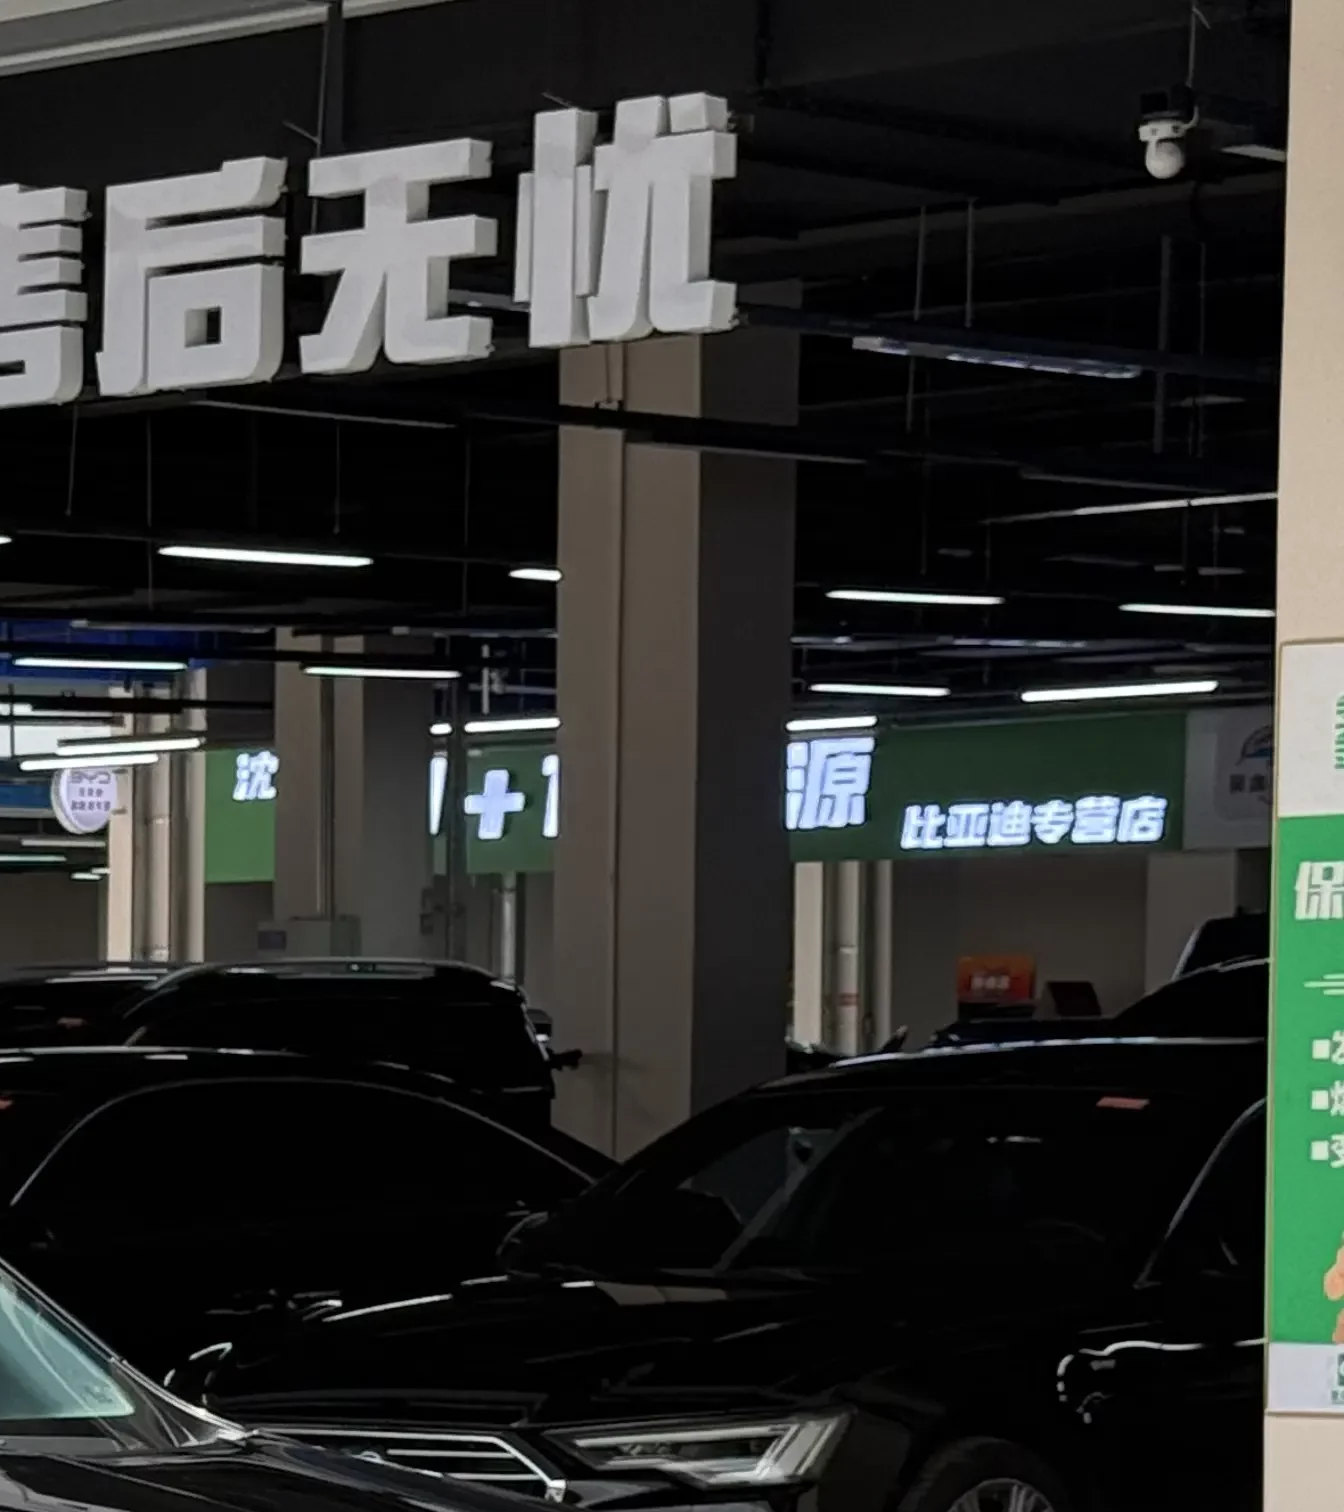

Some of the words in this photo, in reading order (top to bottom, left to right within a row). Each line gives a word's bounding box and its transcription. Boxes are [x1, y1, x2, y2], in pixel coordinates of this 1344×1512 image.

[900, 796, 1168, 850] 比亚迪专营店
